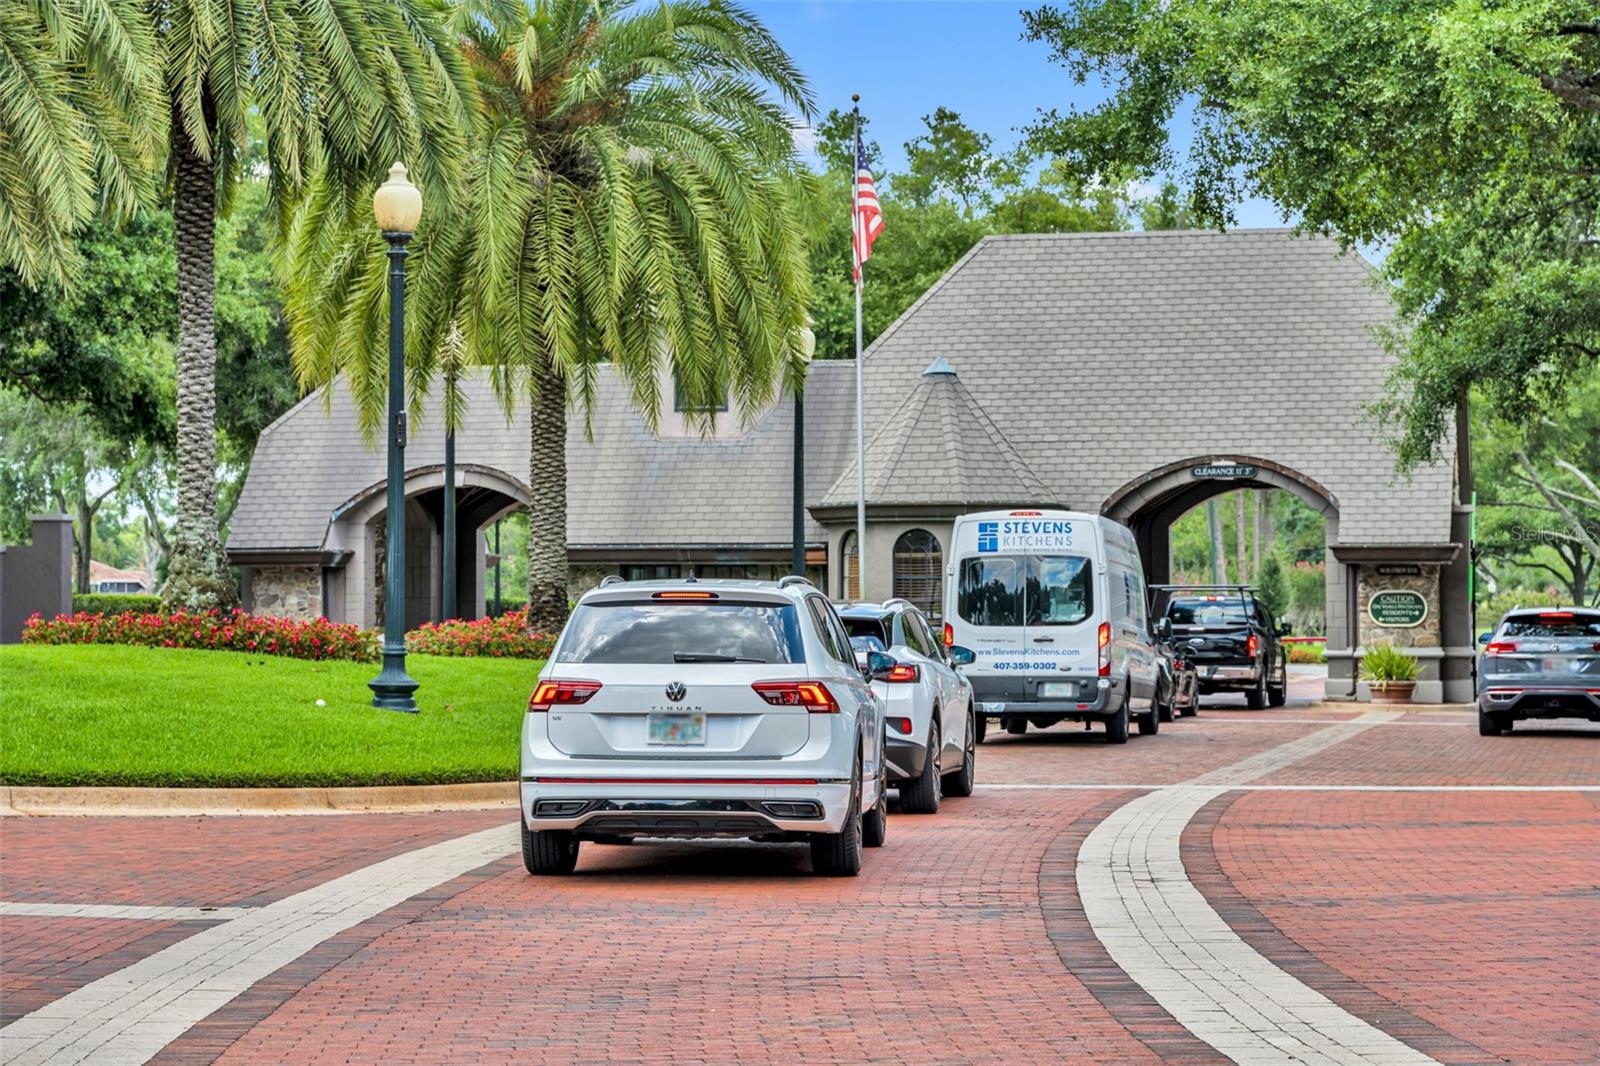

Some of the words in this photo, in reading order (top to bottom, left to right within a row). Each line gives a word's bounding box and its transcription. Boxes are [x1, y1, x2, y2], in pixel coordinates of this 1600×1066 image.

[1194, 467, 1234, 476] CLEARANCE
[1004, 522, 1073, 533] STEVENS
[1003, 536, 1073, 546] KITCHENS
[993, 662, 1057, 670] 407-359-0302
